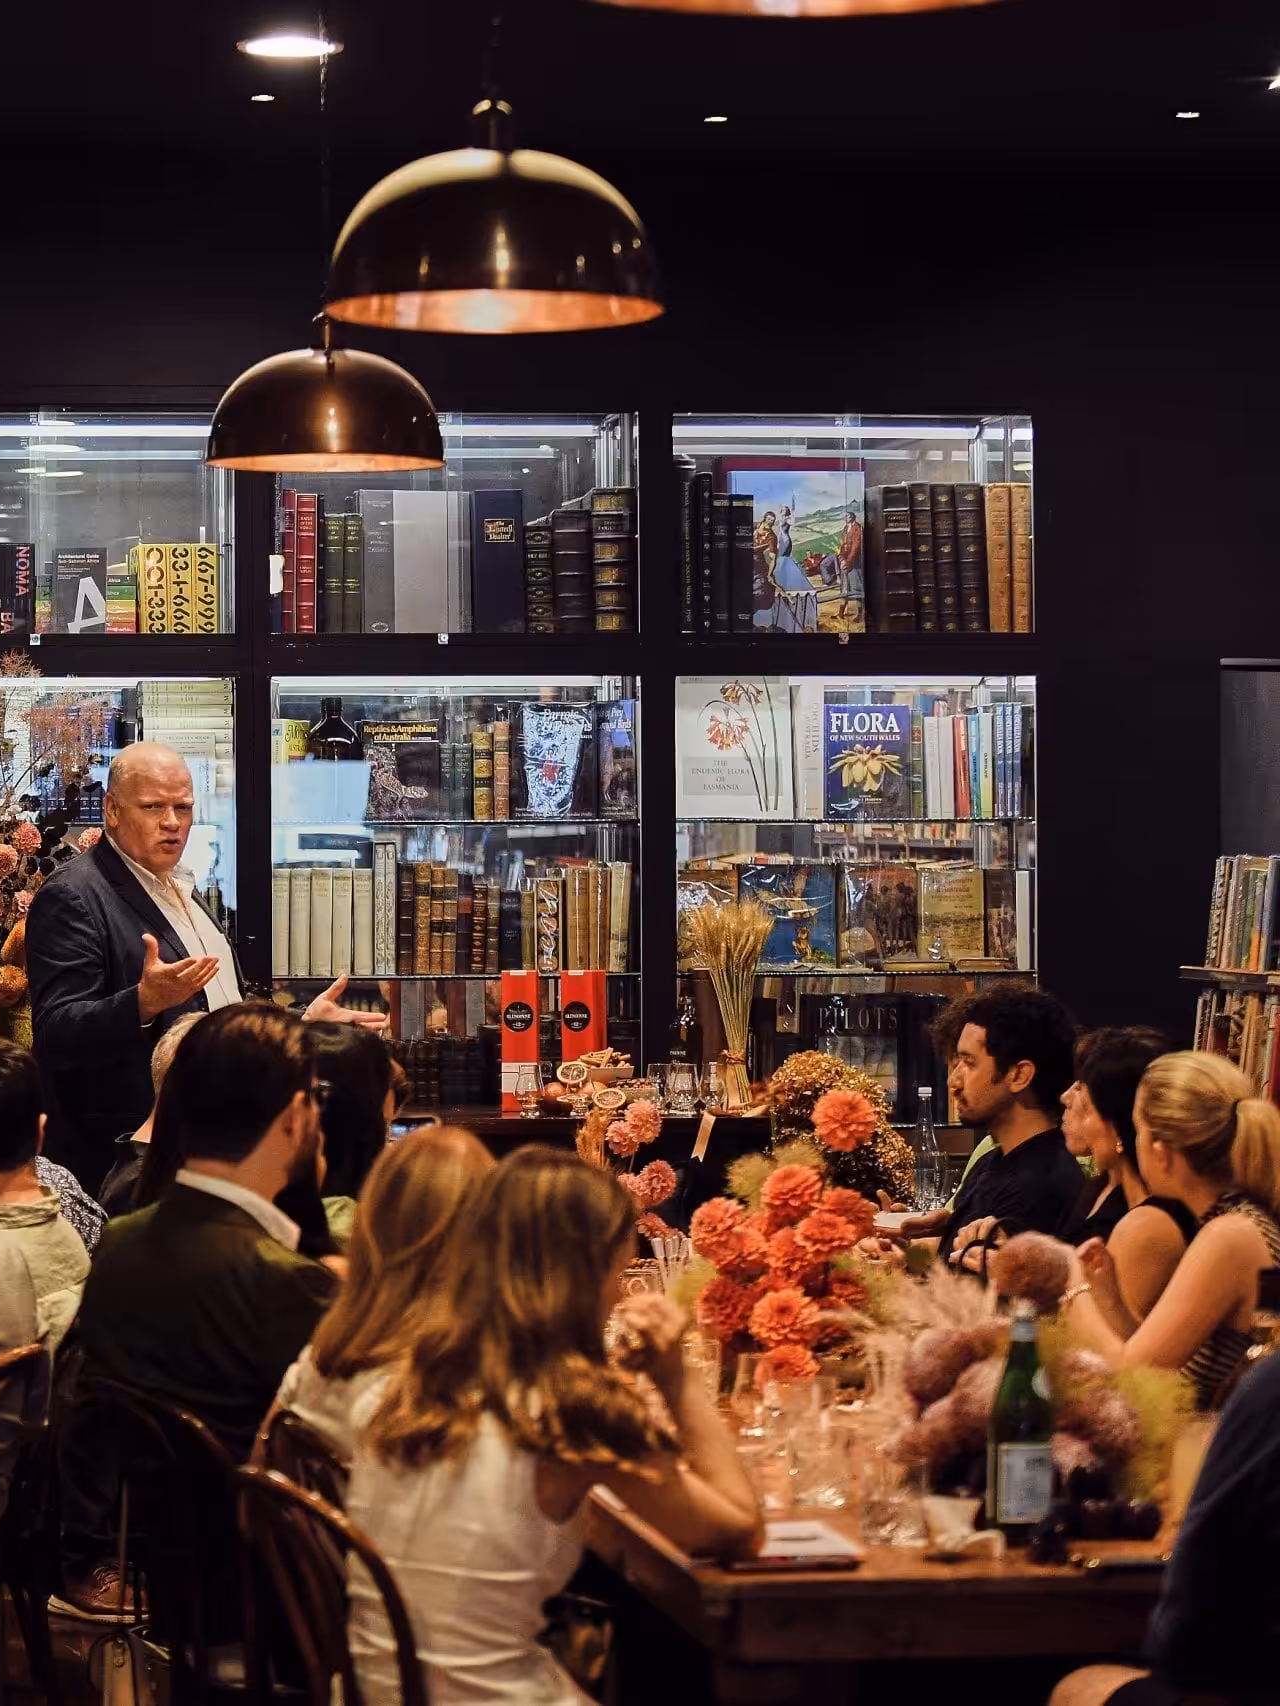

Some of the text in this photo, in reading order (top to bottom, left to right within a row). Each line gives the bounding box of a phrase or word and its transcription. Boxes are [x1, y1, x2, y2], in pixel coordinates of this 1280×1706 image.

[16, 546, 30, 597] NOMA
[197, 547, 215, 633] 667-999
[363, 725, 390, 734] Reptiles
[397, 725, 437, 734] Amphibians
[830, 713, 900, 733] FLORA
[818, 1007, 898, 1030] PILOTS
